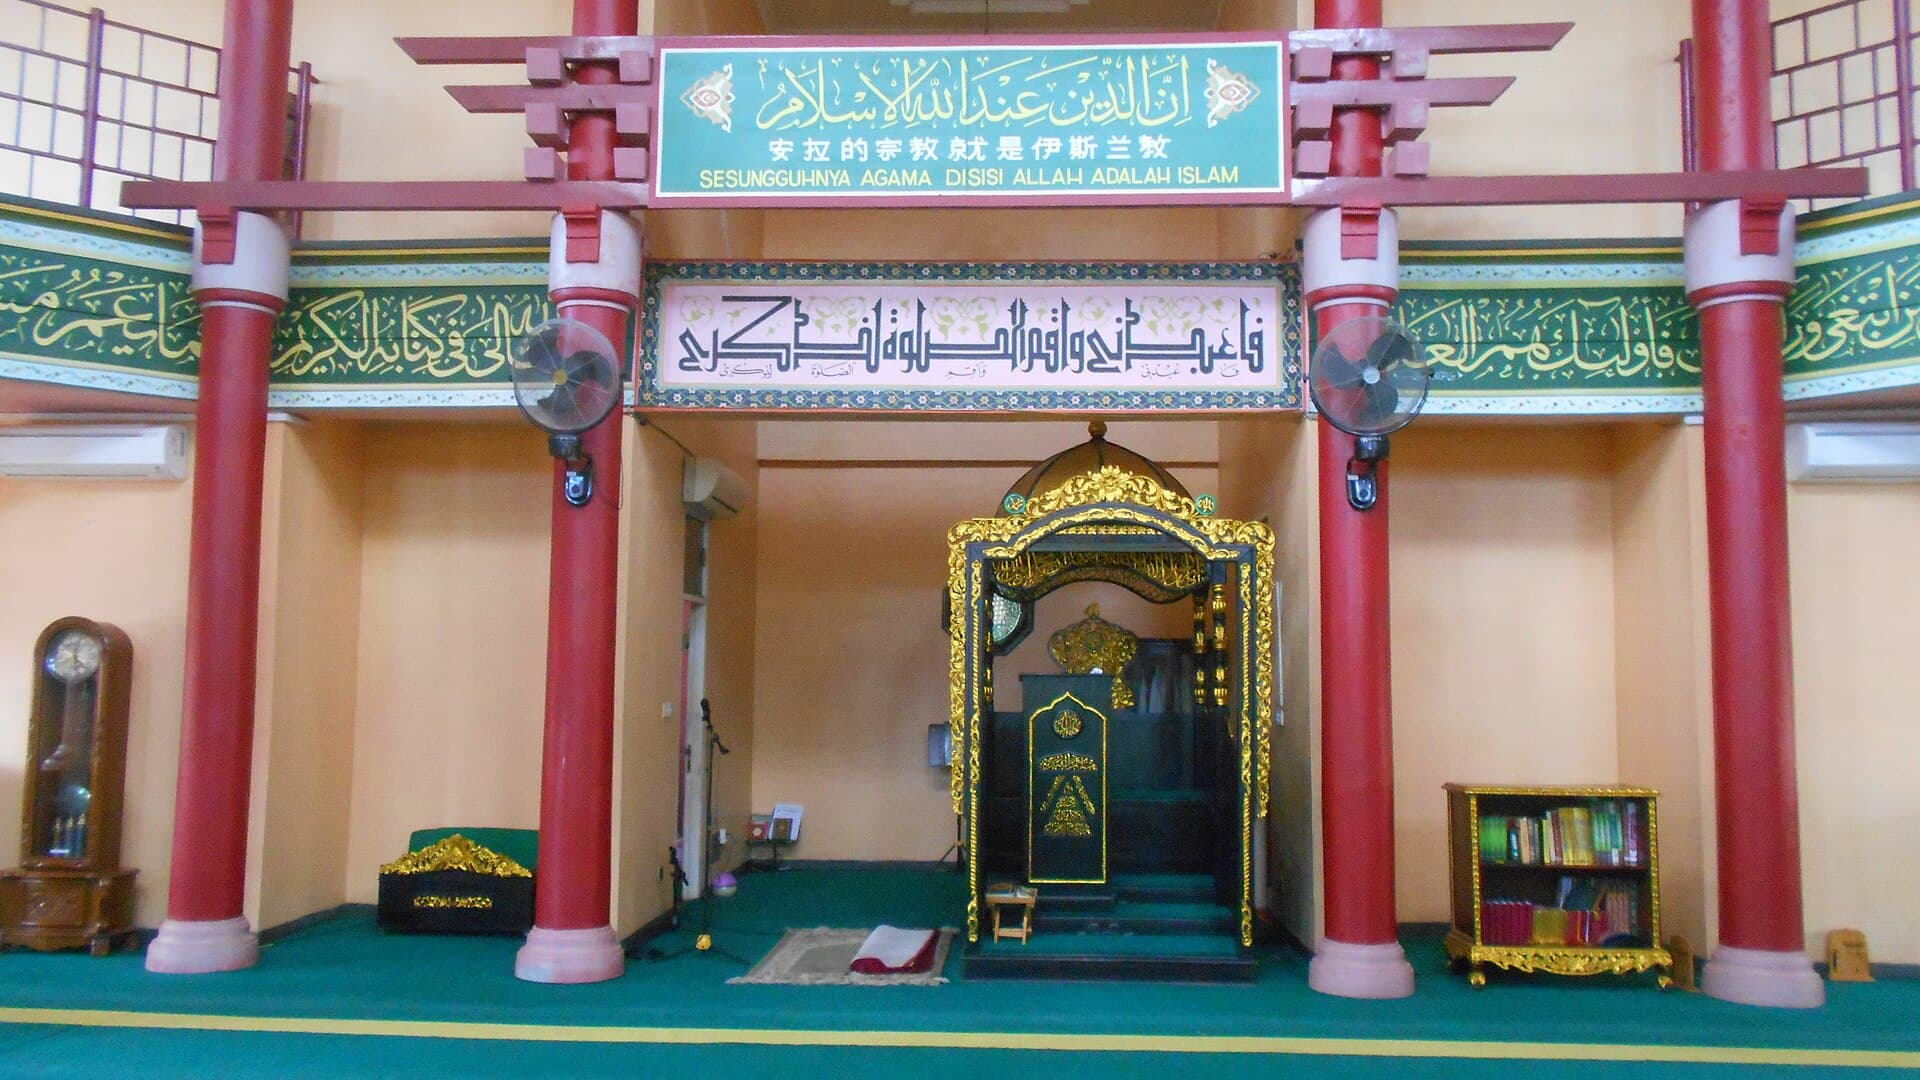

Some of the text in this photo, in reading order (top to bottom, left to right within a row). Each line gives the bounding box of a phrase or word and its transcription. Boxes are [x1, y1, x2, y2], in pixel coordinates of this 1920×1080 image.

[768, 134, 1172, 163] 安拉的宗教就是伊斯兰教
[700, 165, 1239, 189] SESUNGGUHNYA AGAMA DISISI ALLAH ADALAH ISLAM
